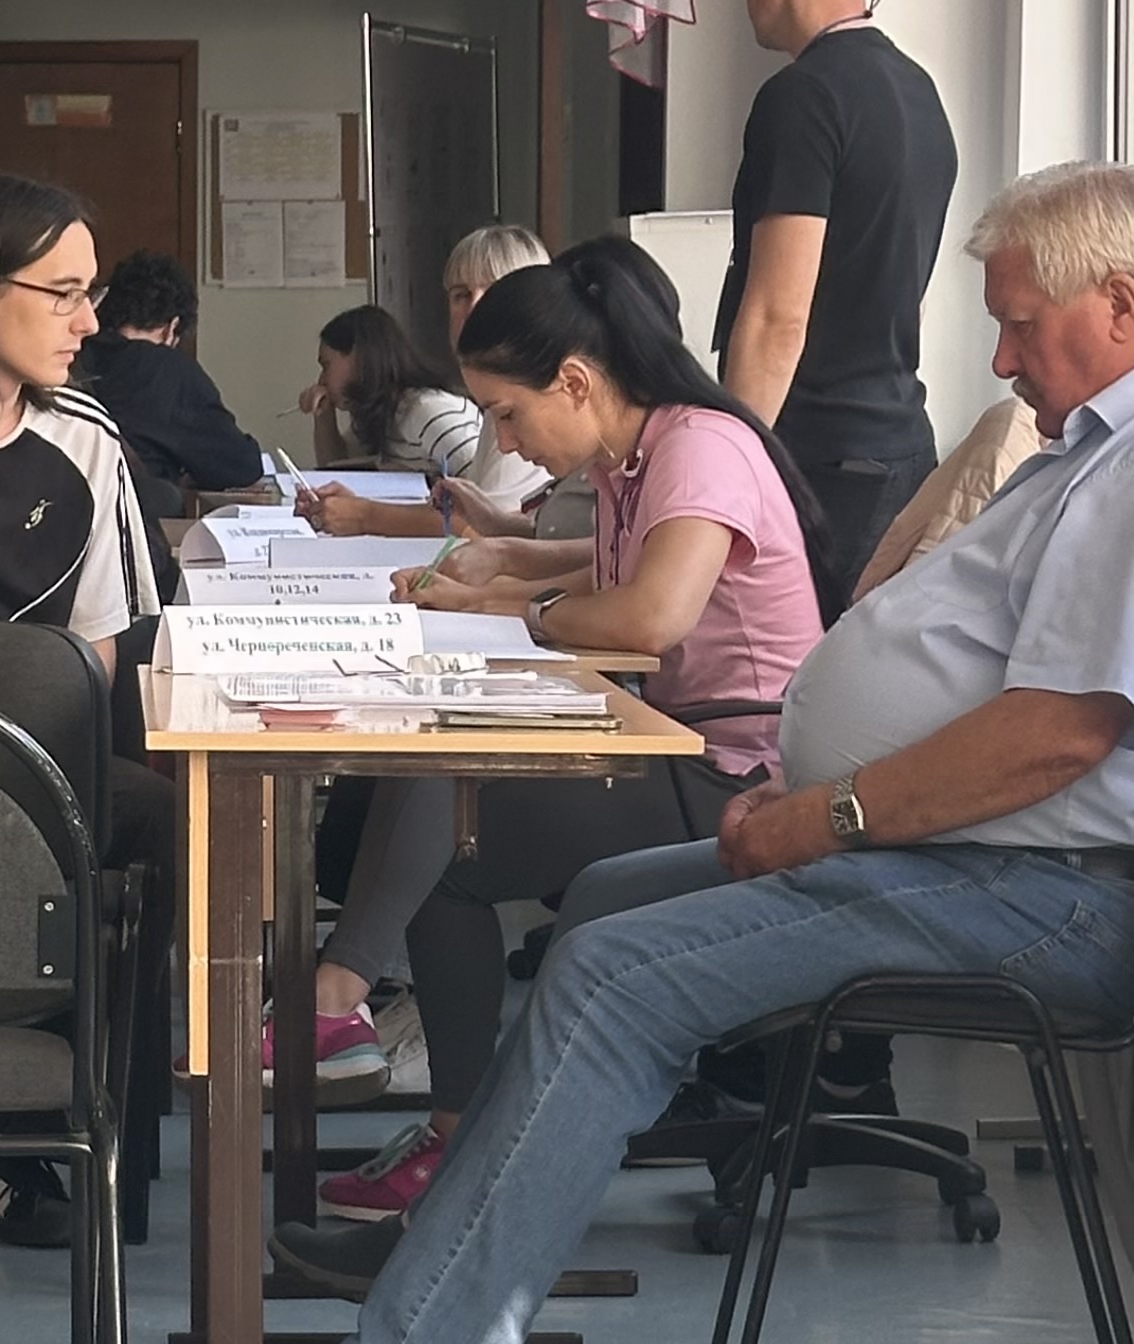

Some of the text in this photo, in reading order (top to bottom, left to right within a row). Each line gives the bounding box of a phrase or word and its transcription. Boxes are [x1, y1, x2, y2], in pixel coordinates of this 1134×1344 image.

[269, 584, 319, 595] 10,12,14
[186, 612, 402, 629] ул. Коммунистическая, д. 23
[202, 637, 395, 656] ул. Чернореченская, д. 18
